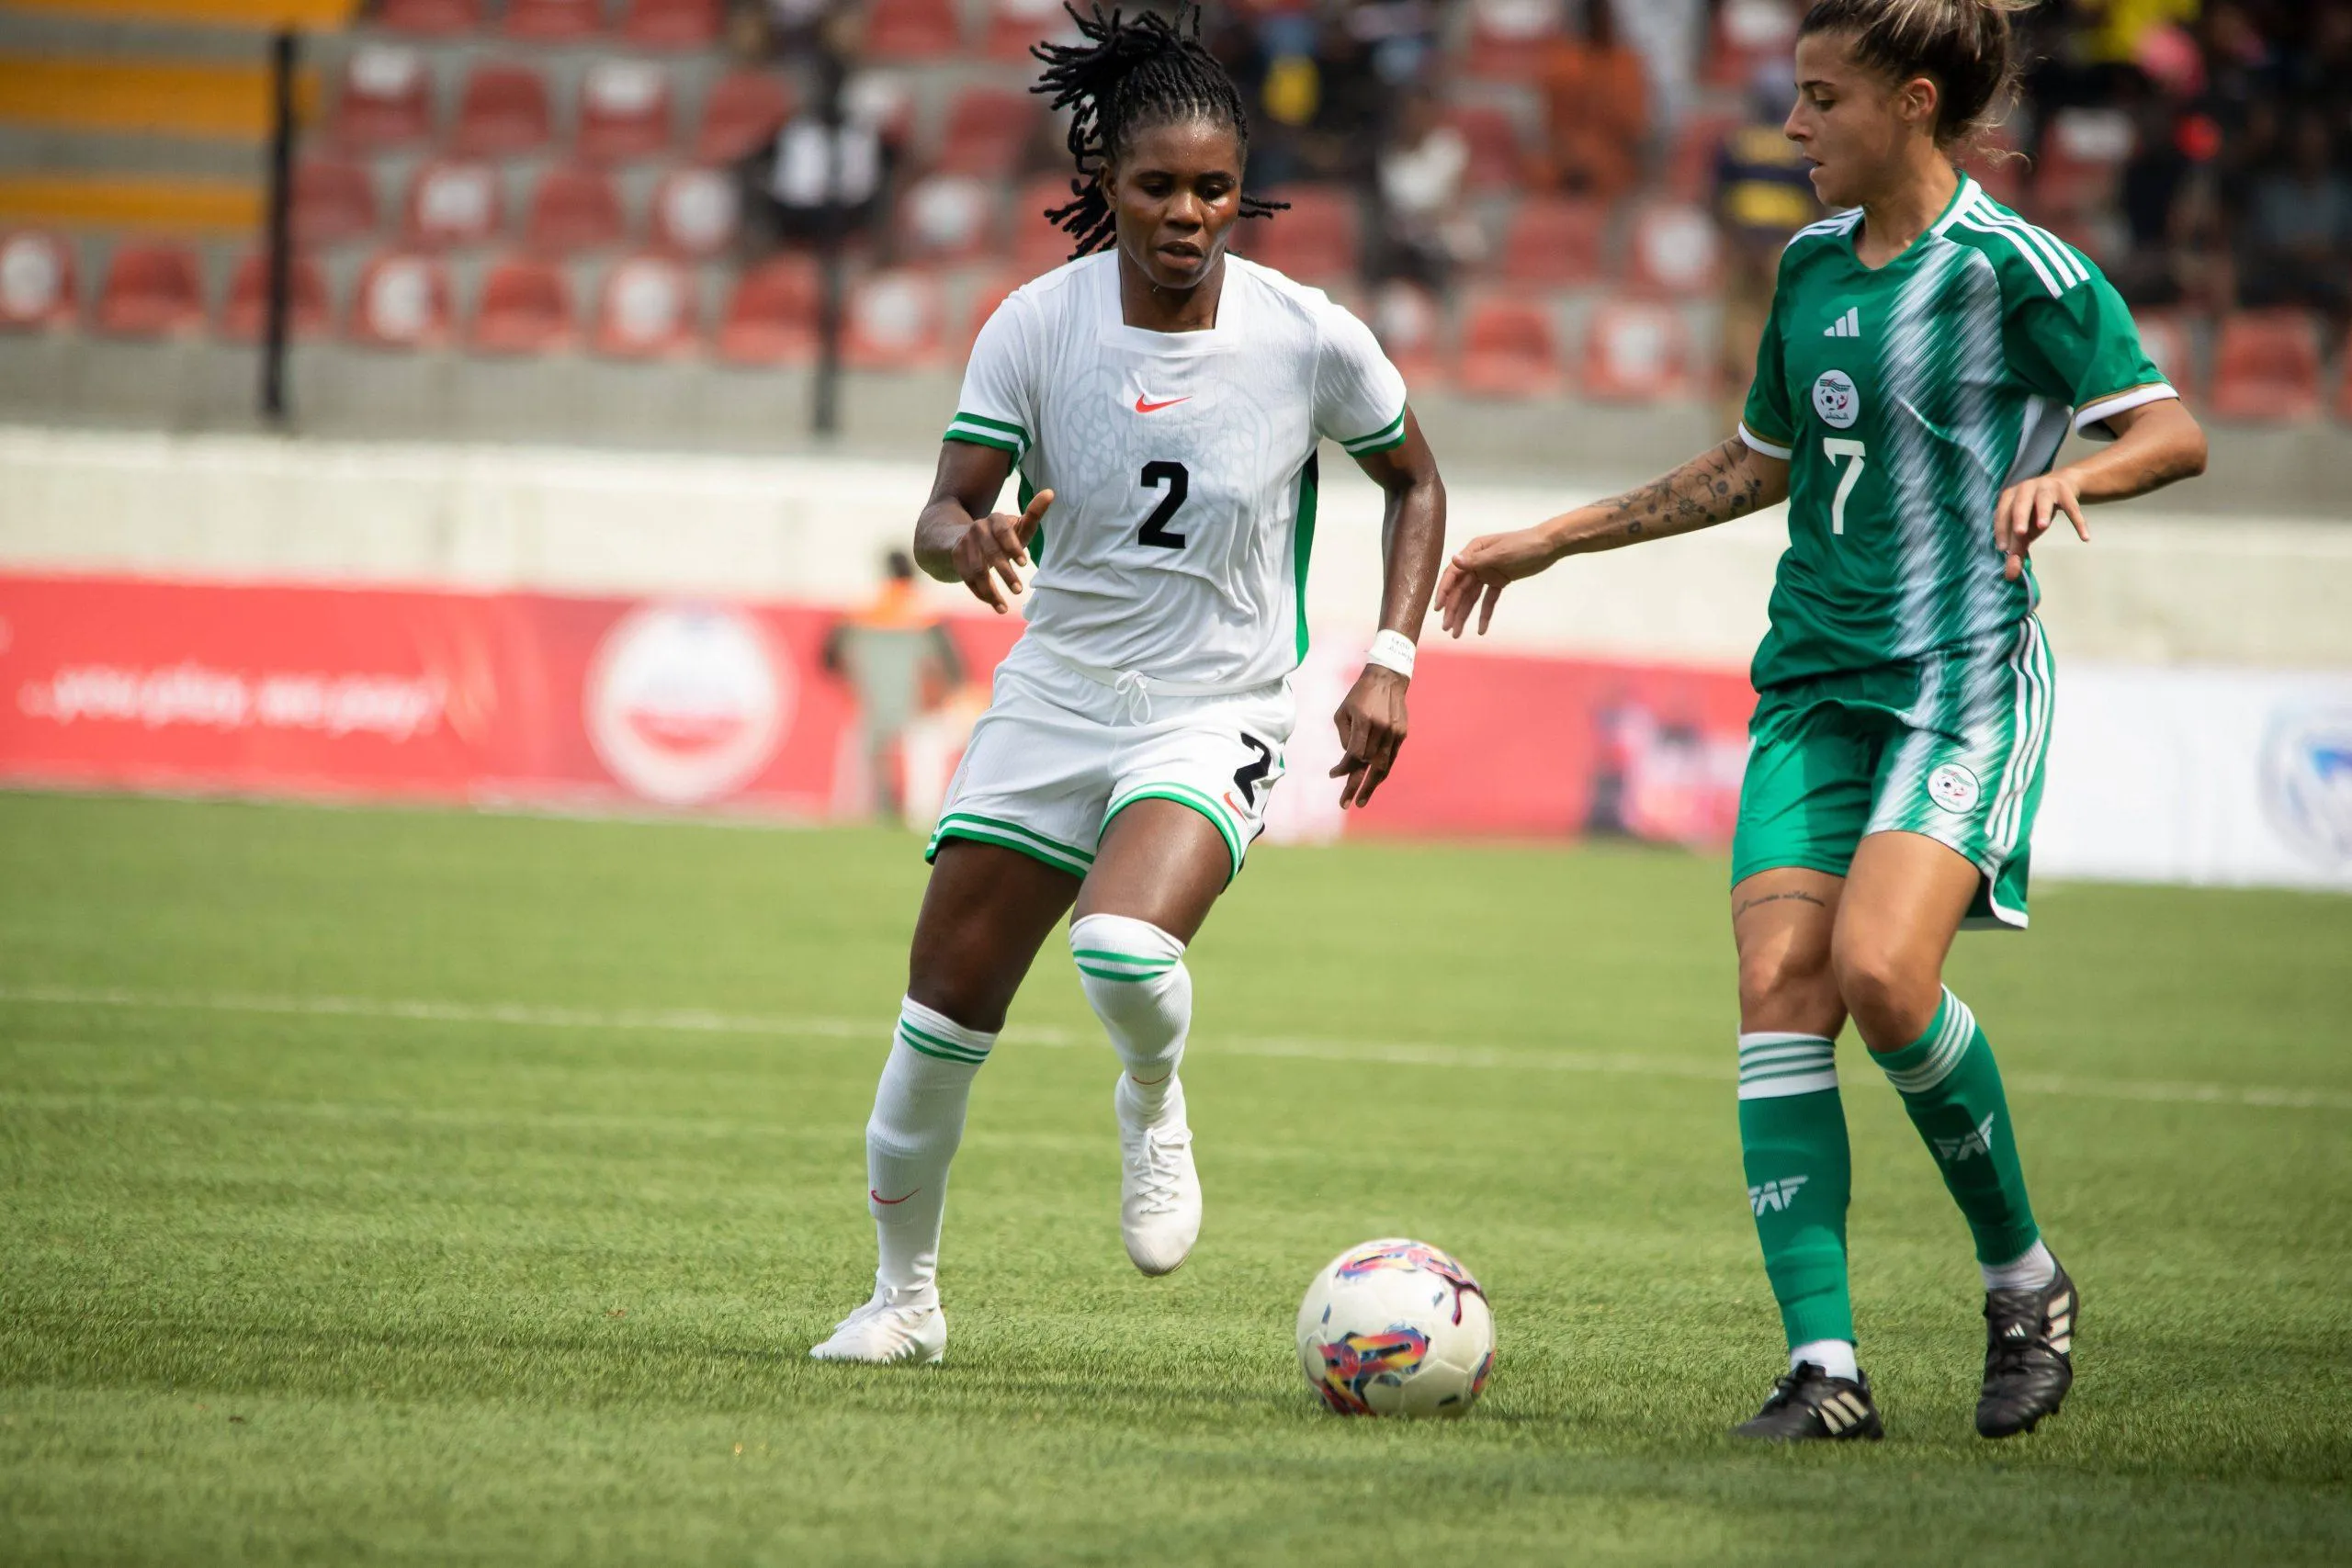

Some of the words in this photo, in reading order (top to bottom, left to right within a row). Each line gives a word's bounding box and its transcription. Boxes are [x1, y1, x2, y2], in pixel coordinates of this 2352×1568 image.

[1138, 461, 1189, 549] 2
[1823, 436, 1866, 535] 7
[1233, 731, 1272, 810] 2
